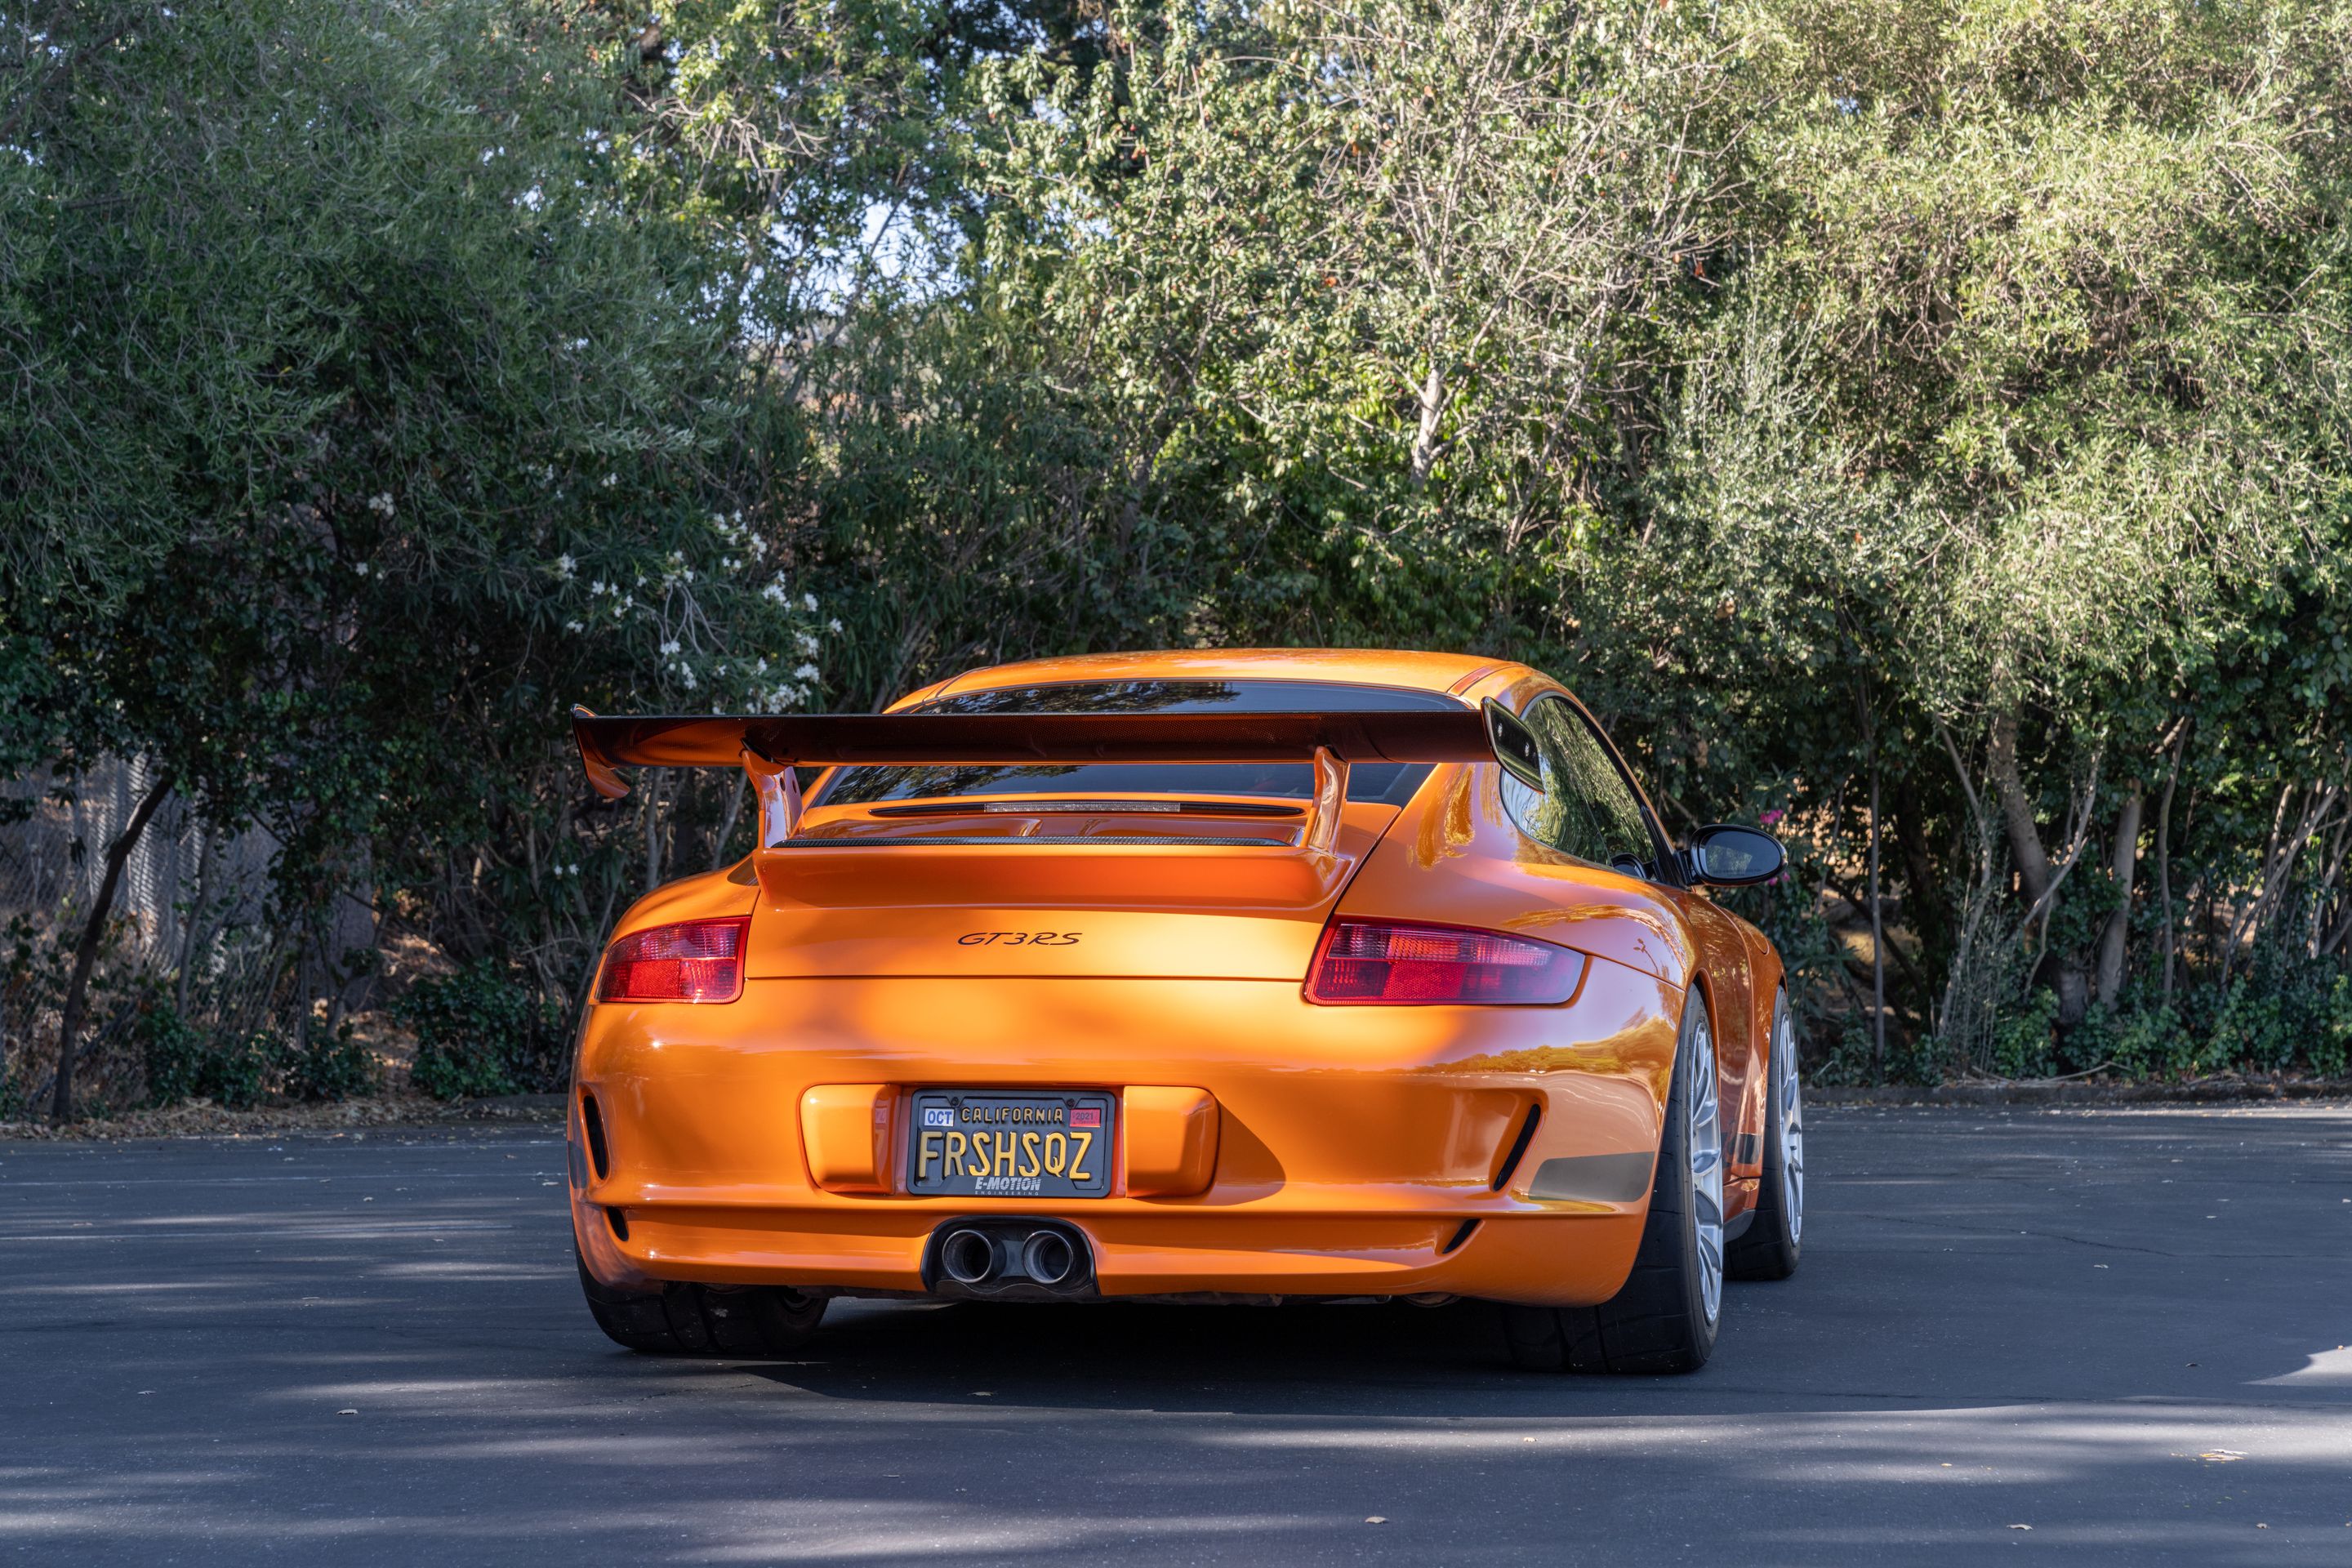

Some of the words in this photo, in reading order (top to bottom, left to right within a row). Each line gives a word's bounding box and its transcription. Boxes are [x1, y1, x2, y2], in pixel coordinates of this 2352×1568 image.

[927, 1110, 952, 1125] OCT
[961, 1107, 1063, 1123] CALIFORNIA
[1076, 1111, 1094, 1120] 2021
[918, 1131, 1093, 1179] FRSHSQZ
[974, 1177, 1041, 1191] E-MOTION
